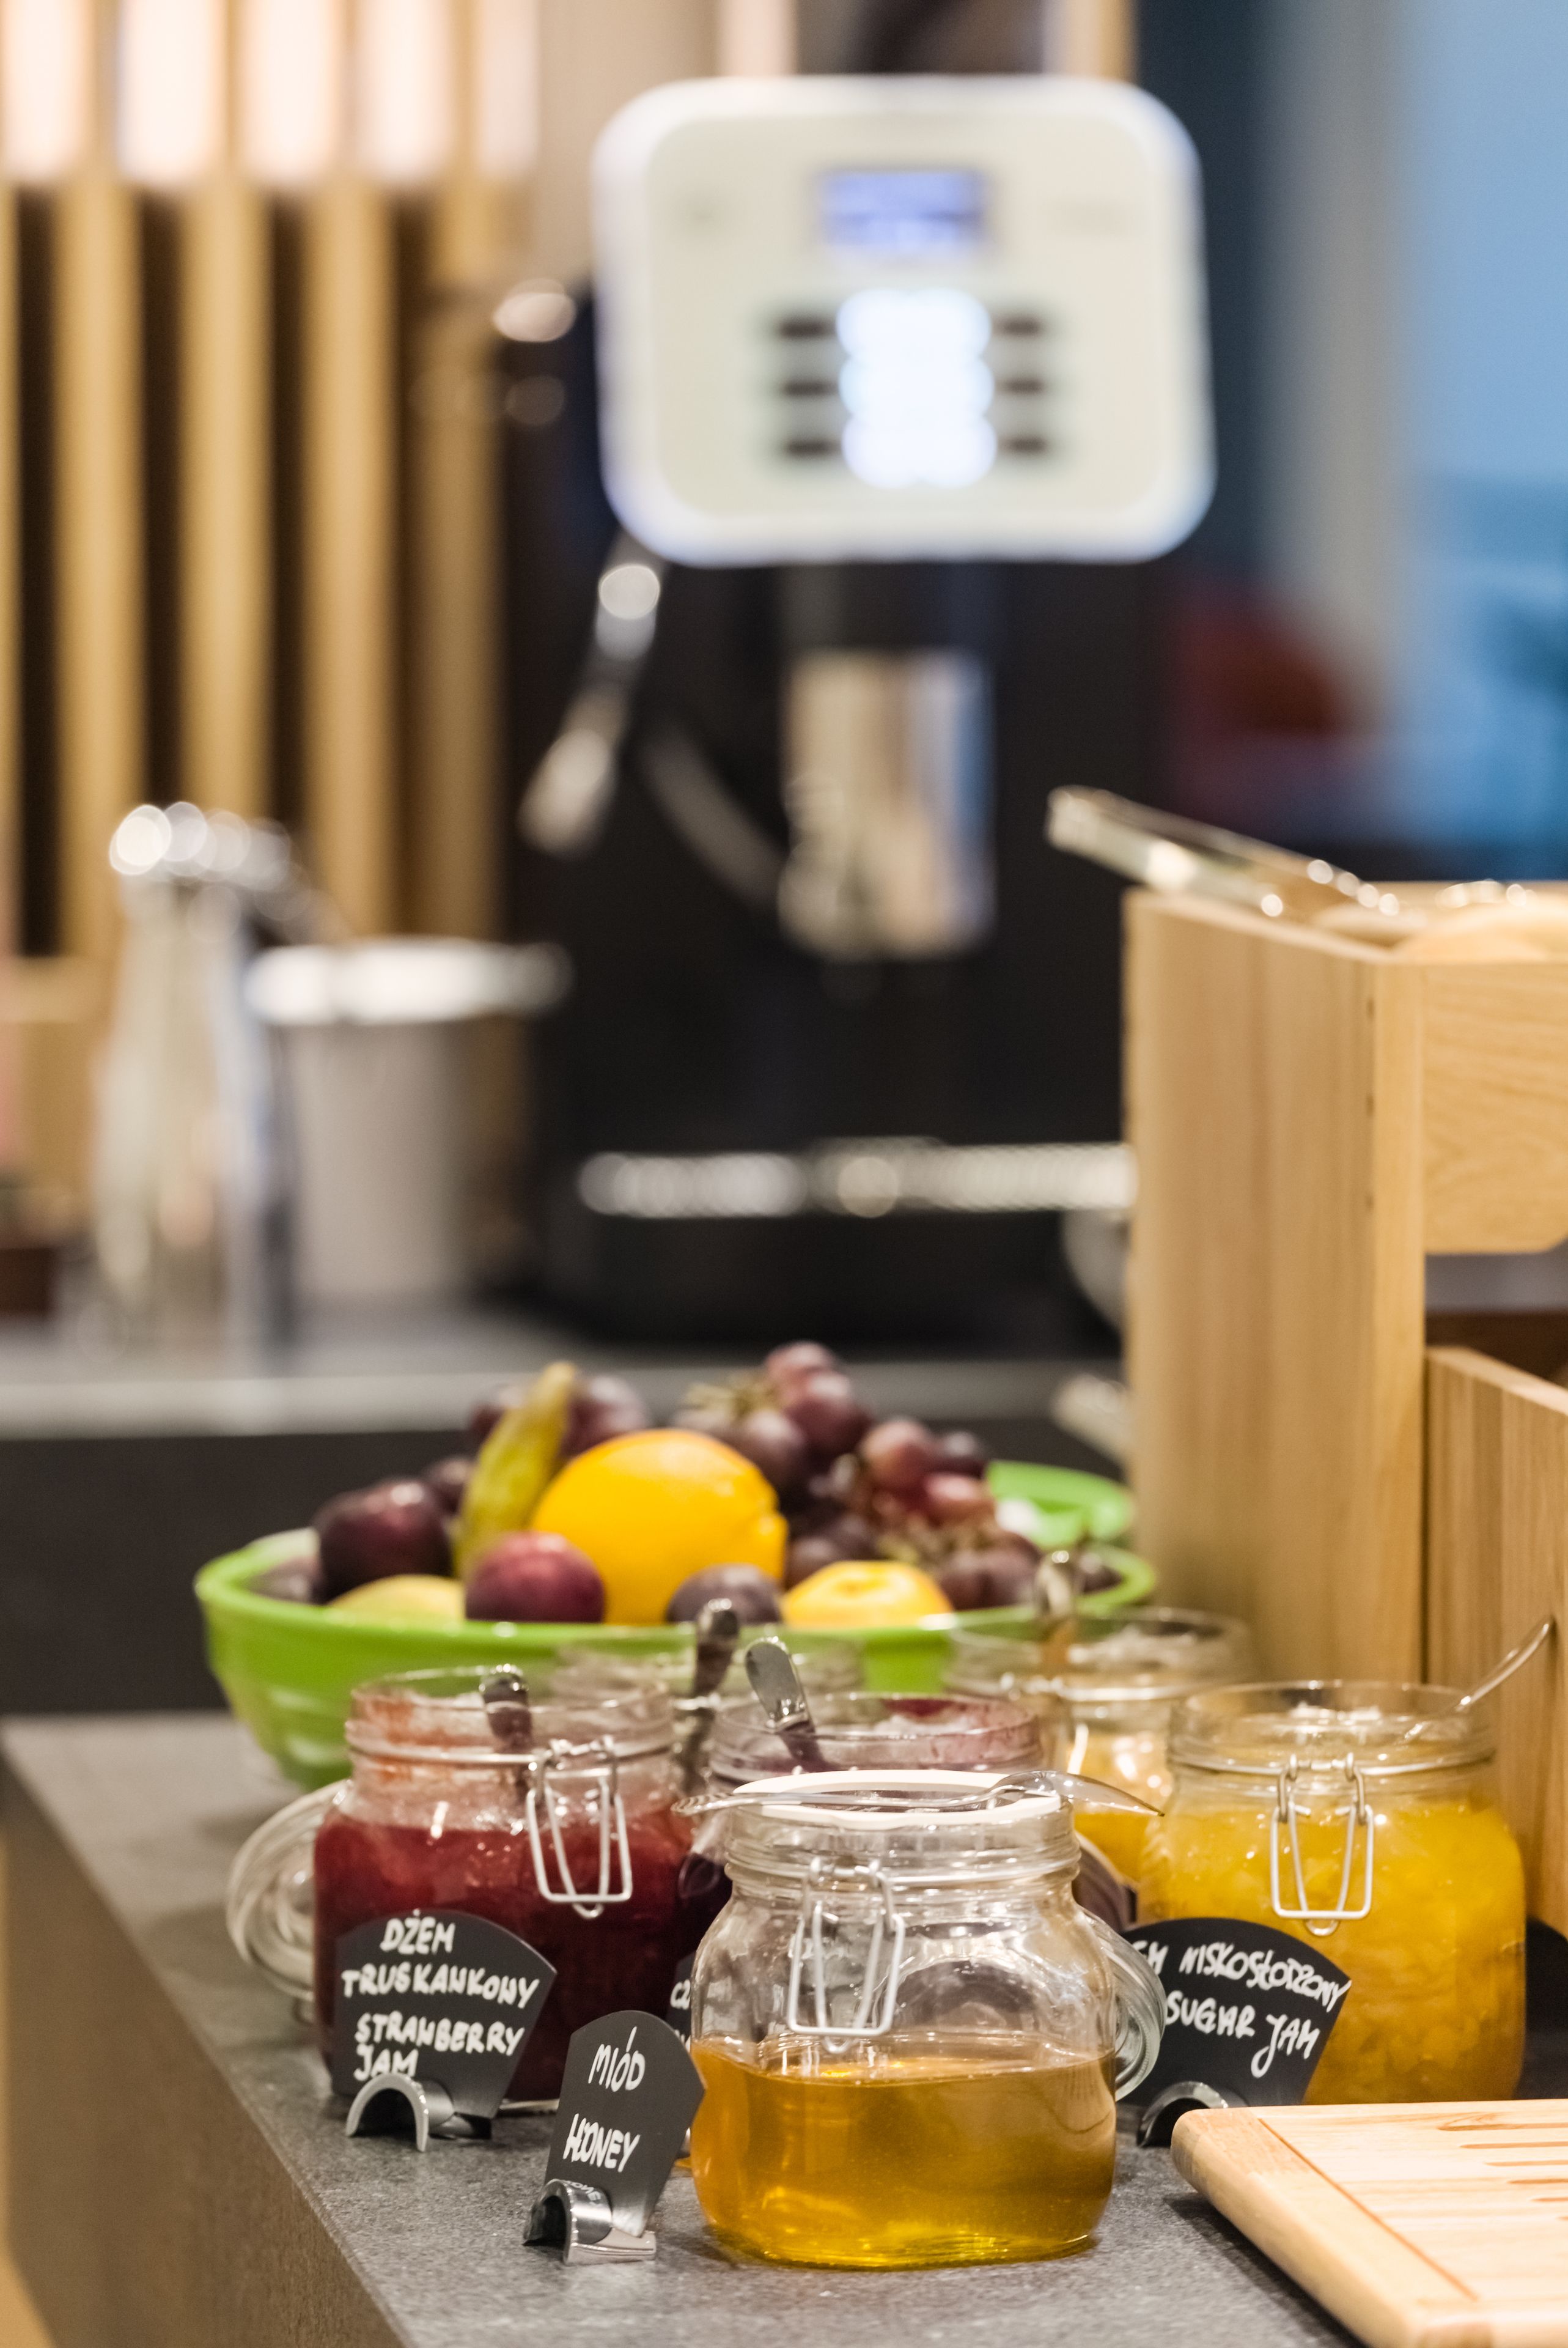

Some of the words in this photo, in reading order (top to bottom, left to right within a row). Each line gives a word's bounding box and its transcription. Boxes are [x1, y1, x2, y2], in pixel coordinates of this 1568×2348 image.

[380, 1908, 456, 1955] DŻEM
[353, 2043, 419, 2082] JAM
[587, 2026, 646, 2092] MIÓD
[1165, 1990, 1256, 2039] SUGAR
[1251, 2014, 1320, 2079] JAM
[562, 2113, 641, 2173] HONEY
